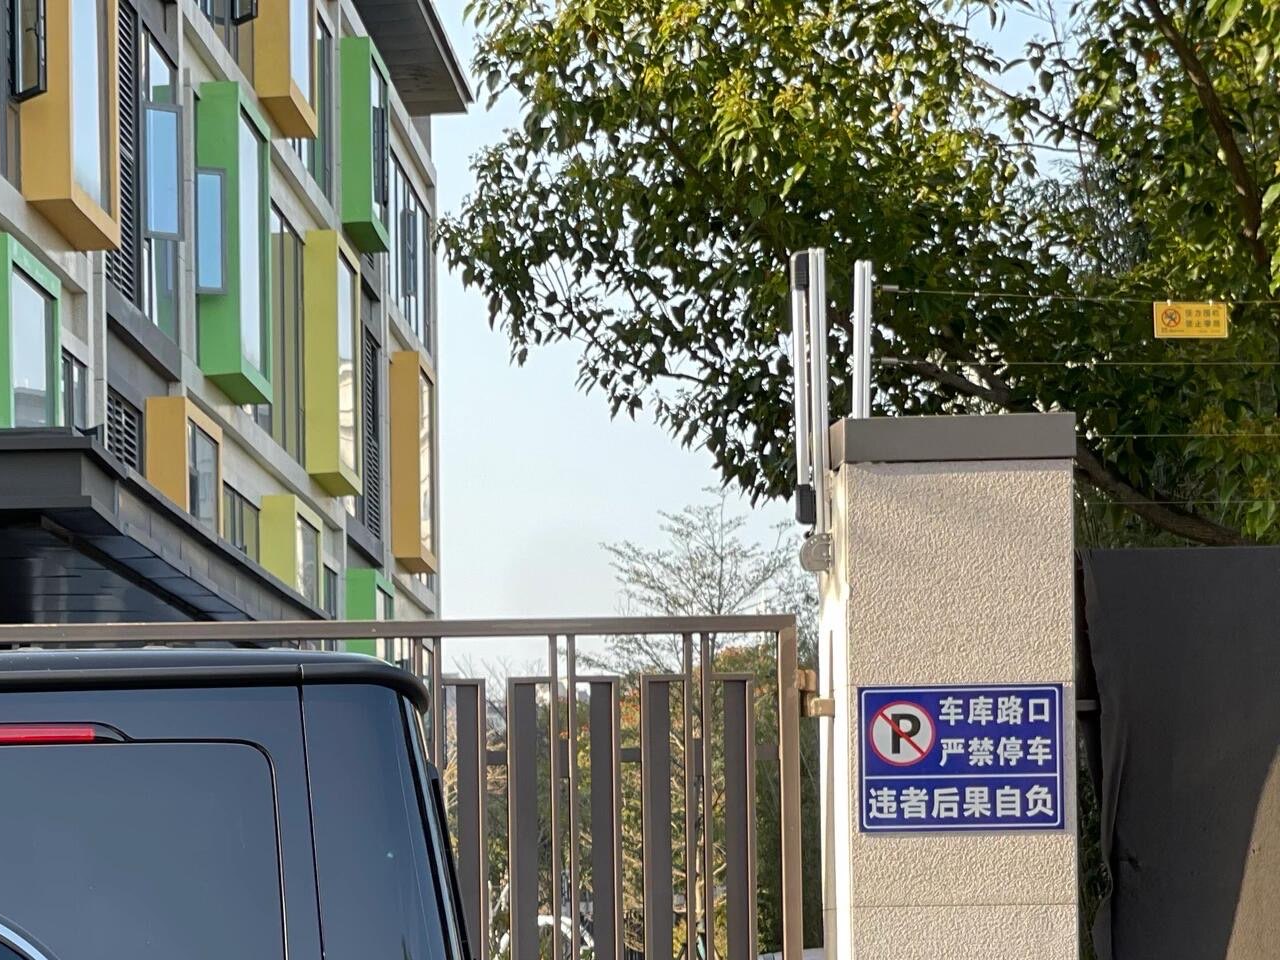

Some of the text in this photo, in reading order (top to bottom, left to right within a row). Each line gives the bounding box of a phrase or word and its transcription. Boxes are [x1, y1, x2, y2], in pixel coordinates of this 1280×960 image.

[939, 695, 1050, 726] 车库路口
[939, 736, 1052, 767] 严禁停车
[868, 784, 1054, 819] 违者后果自负
